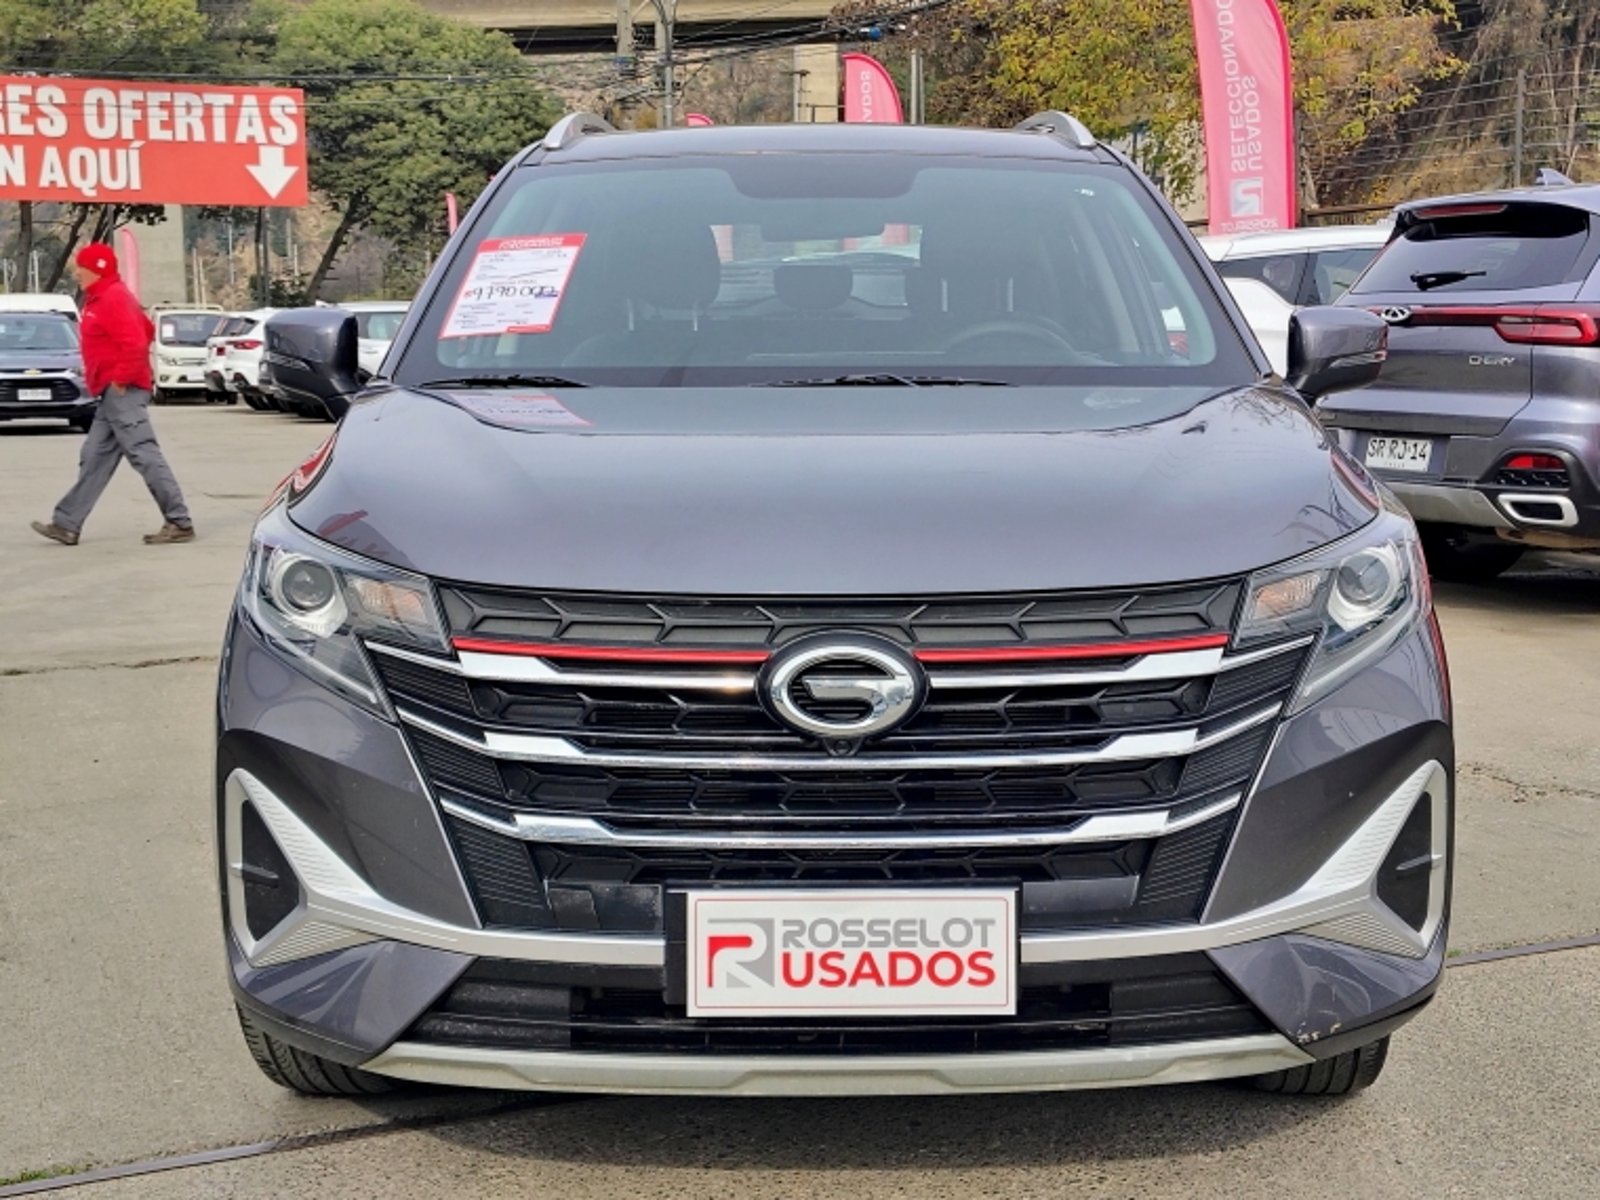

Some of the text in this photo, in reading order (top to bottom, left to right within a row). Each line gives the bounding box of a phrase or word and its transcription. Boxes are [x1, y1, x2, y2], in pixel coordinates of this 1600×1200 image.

[0, 83, 299, 147] ES OFERTAS
[38, 140, 146, 197] AQUÍ
[782, 917, 996, 949] ROSSELOT
[782, 951, 996, 989] USADOS
